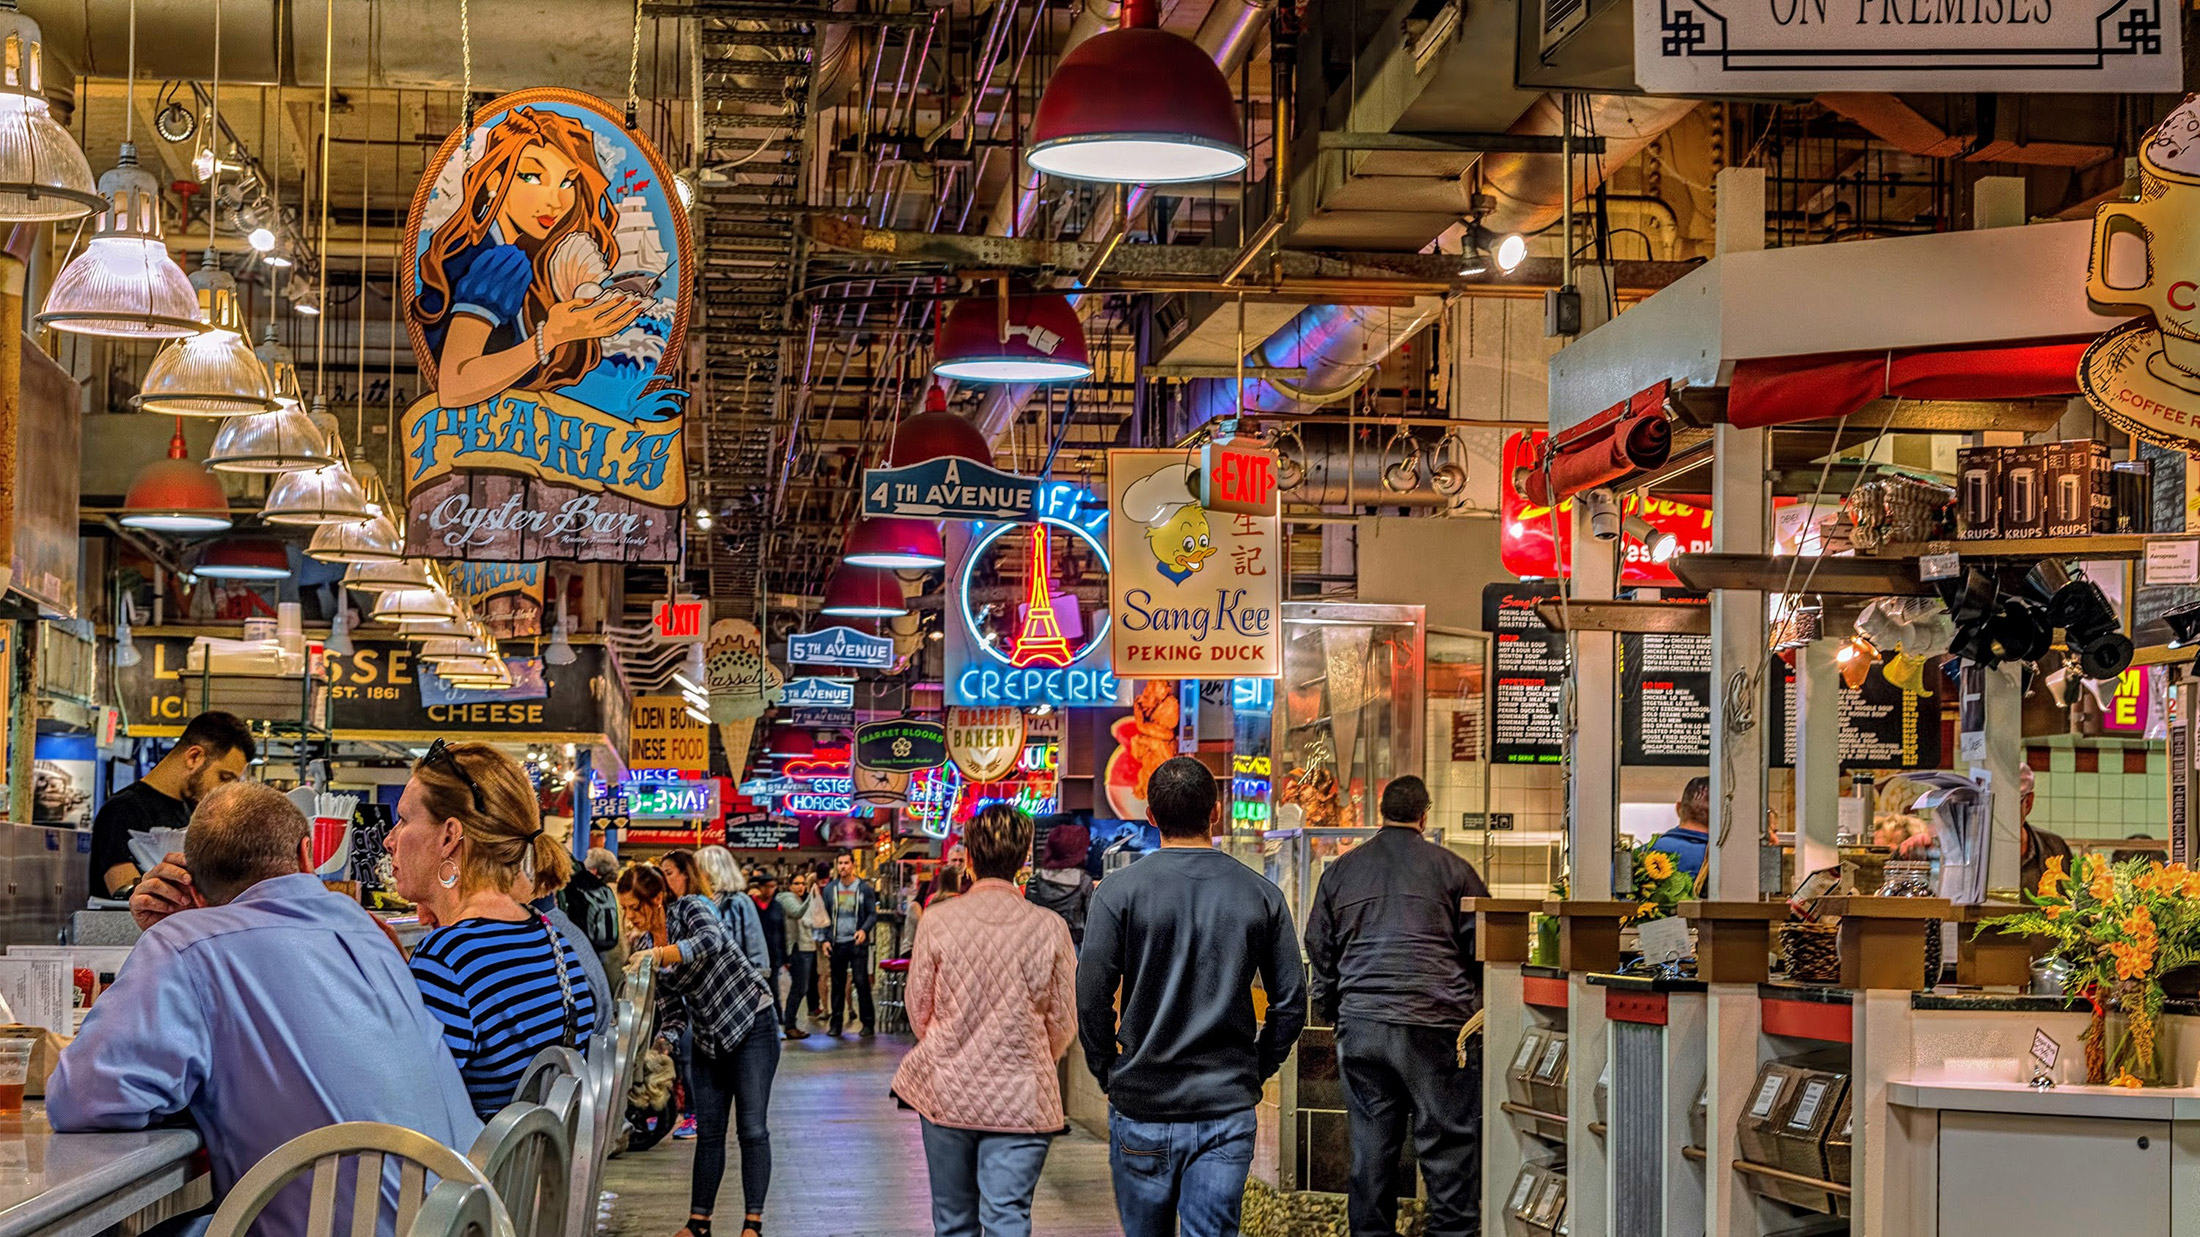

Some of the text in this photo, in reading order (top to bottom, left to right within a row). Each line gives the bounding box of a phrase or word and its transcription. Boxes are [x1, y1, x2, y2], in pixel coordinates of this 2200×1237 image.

[1771, 0, 2052, 26] ON PREMISES
[2119, 388, 2200, 429] COFFEE R
[411, 395, 681, 491] PEARL'S
[944, 459, 961, 485] A
[1220, 451, 1271, 505] EXIT
[925, 484, 1032, 509] AVENUE
[430, 493, 641, 547] Oyster Bar
[2049, 524, 2087, 536] KRUPS
[1960, 528, 1997, 540] KRUPS
[2005, 527, 2043, 539] KRUPS
[1499, 595, 1531, 610] Sang
[661, 603, 703, 637] EXIT
[1121, 587, 1271, 641] Sang Kee
[834, 629, 847, 645] A
[793, 642, 889, 659] 5TH AVENUE
[1127, 644, 1265, 662] PEKING DUCK
[366, 686, 400, 700] 1861
[801, 688, 849, 700] AVENUE
[960, 669, 1118, 701] CREPERIE
[151, 696, 544, 724] IC CHEESE
[634, 707, 665, 729] LDEN
[814, 712, 853, 722] AVENUE
[958, 708, 1012, 726] MARKET
[860, 728, 944, 744] MARKET BLOOMS
[953, 728, 1016, 748] BAKERY
[671, 738, 704, 760] FOOD
[1018, 746, 1060, 771] JUIC
[592, 805, 628, 817] ERE
[793, 795, 850, 810] HOAGIES
